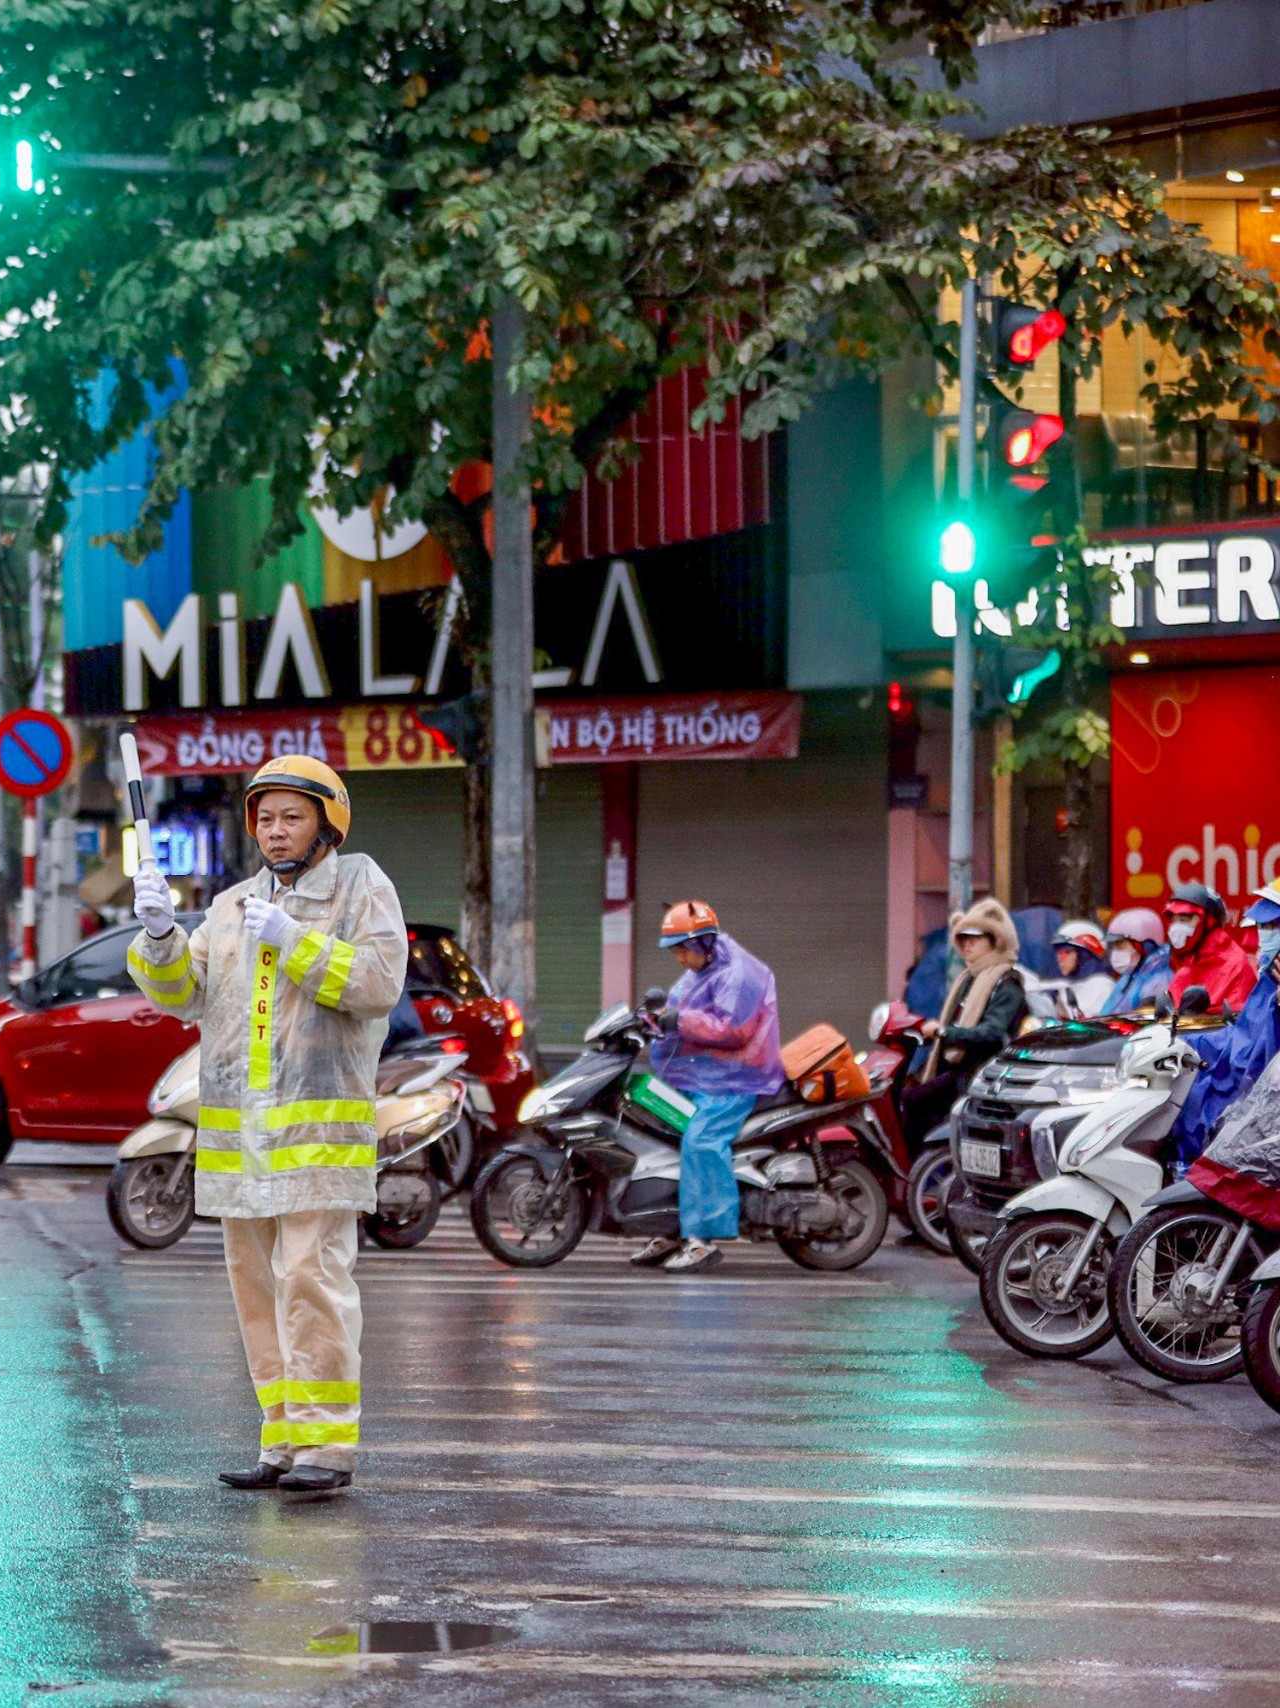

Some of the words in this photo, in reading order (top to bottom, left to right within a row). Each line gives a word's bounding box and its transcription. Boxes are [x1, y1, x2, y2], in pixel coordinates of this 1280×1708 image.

[273, 717, 328, 763] GIÁ
[576, 709, 615, 755] BỘ
[622, 707, 656, 754] HỆ
[663, 701, 761, 745] THỐNG
